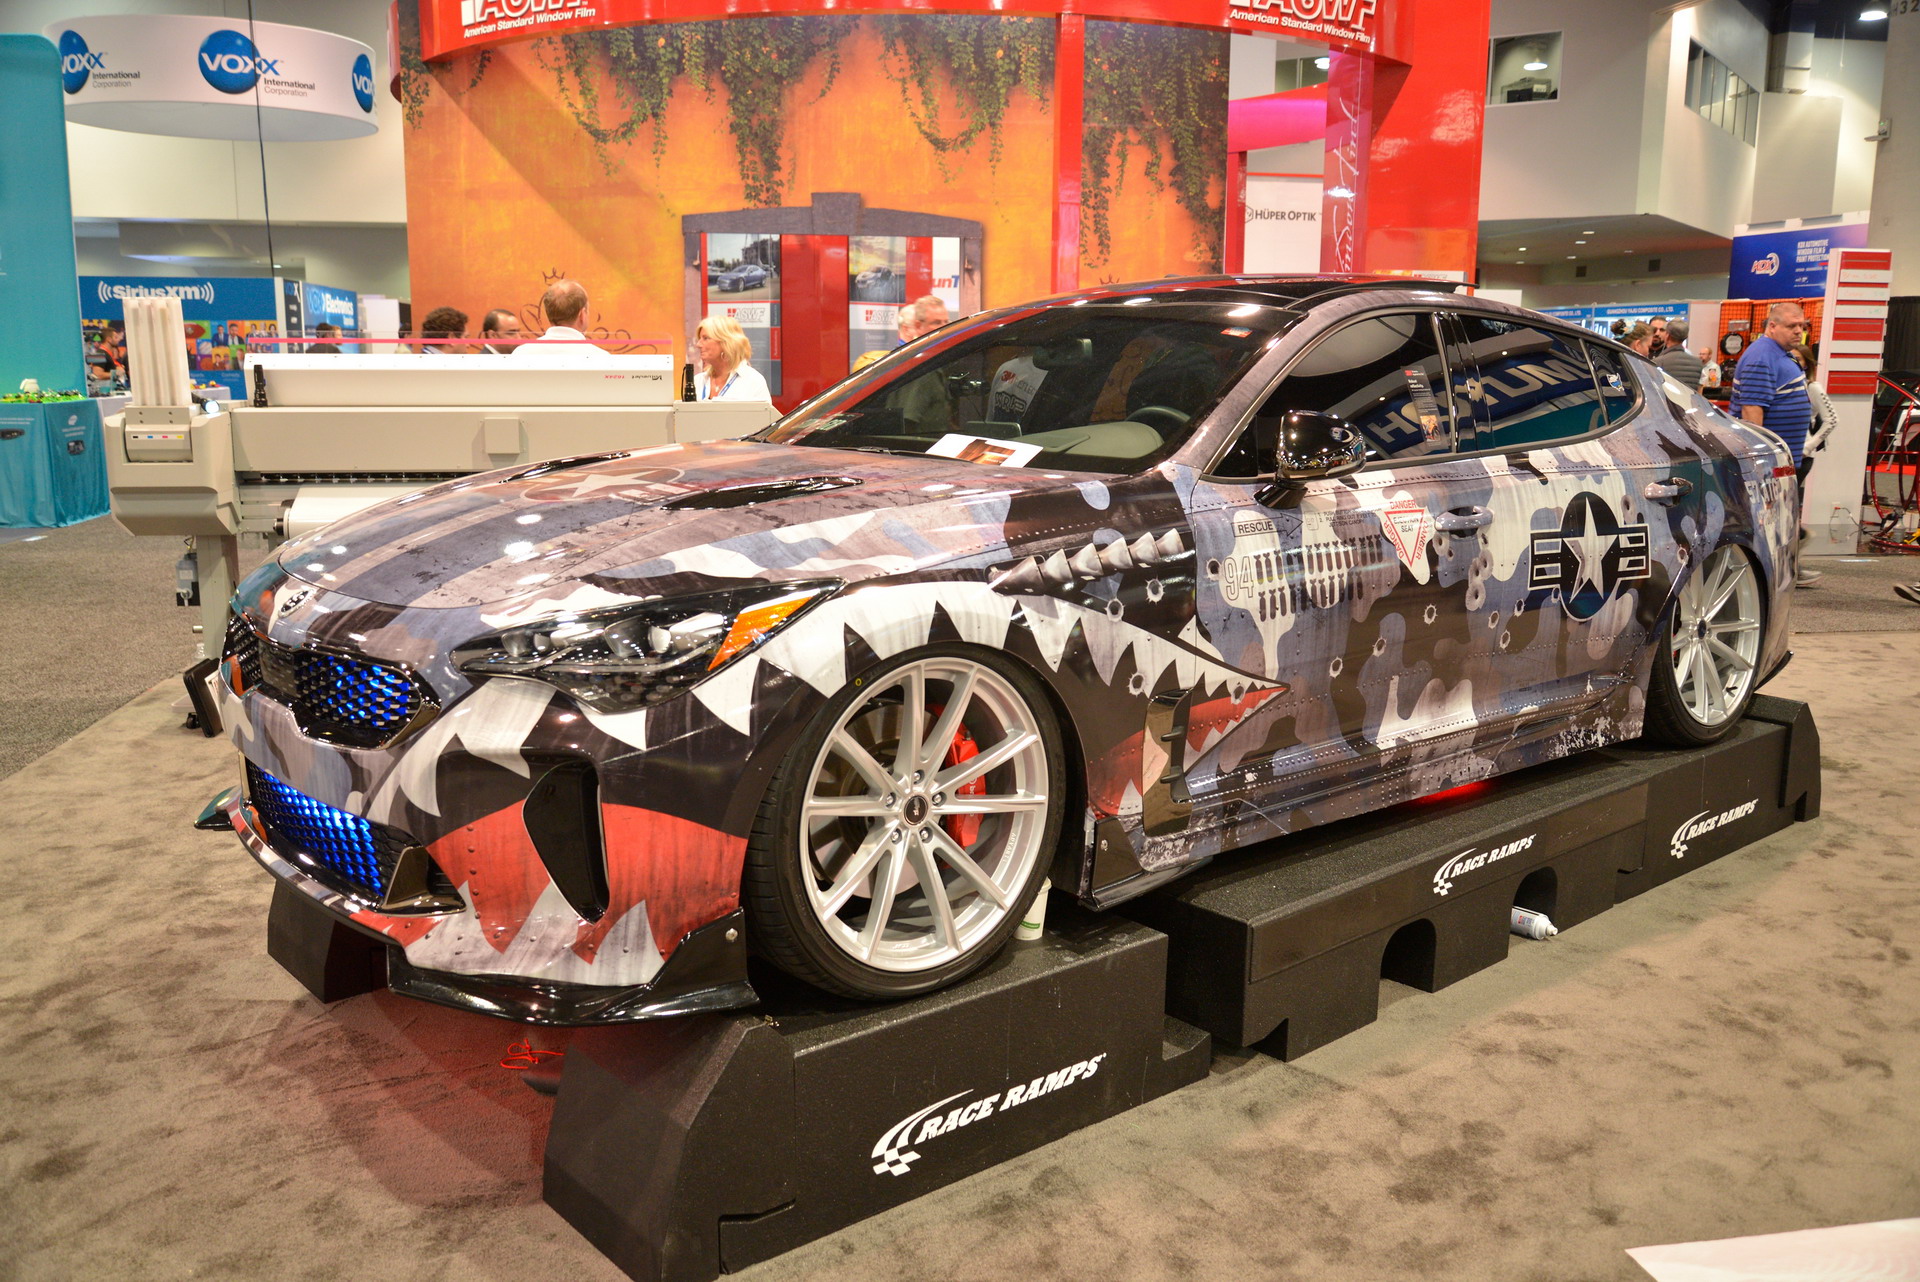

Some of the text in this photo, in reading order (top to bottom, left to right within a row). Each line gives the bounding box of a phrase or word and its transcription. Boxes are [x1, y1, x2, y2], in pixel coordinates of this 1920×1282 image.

[464, 22, 496, 38] American
[497, 15, 534, 30] Standard
[536, 10, 573, 24] Window
[575, 7, 596, 19] Film
[1229, 8, 1279, 25] American
[1281, 15, 1323, 33] Standard
[1324, 24, 1356, 40] Window
[1355, 32, 1371, 44] Film
[92, 71, 141, 80] International
[201, 52, 281, 76] VOXX
[92, 80, 132, 89] Corporation
[264, 77, 316, 91] International
[264, 86, 308, 97] Corporation
[1255, 208, 1317, 222] HÜPER OPTIK
[1389, 499, 1417, 510] DANGER
[1238, 519, 1273, 535] RESCUE
[1401, 525, 1414, 533] SEAT
[1383, 520, 1405, 559] DANGER
[1415, 520, 1430, 560] DANGER
[1223, 556, 1255, 601] 94
[1686, 801, 1757, 840] RACE RAMPS
[1450, 835, 1536, 879] RACE RAMPS
[914, 1054, 1102, 1145] RACE RAMPS
